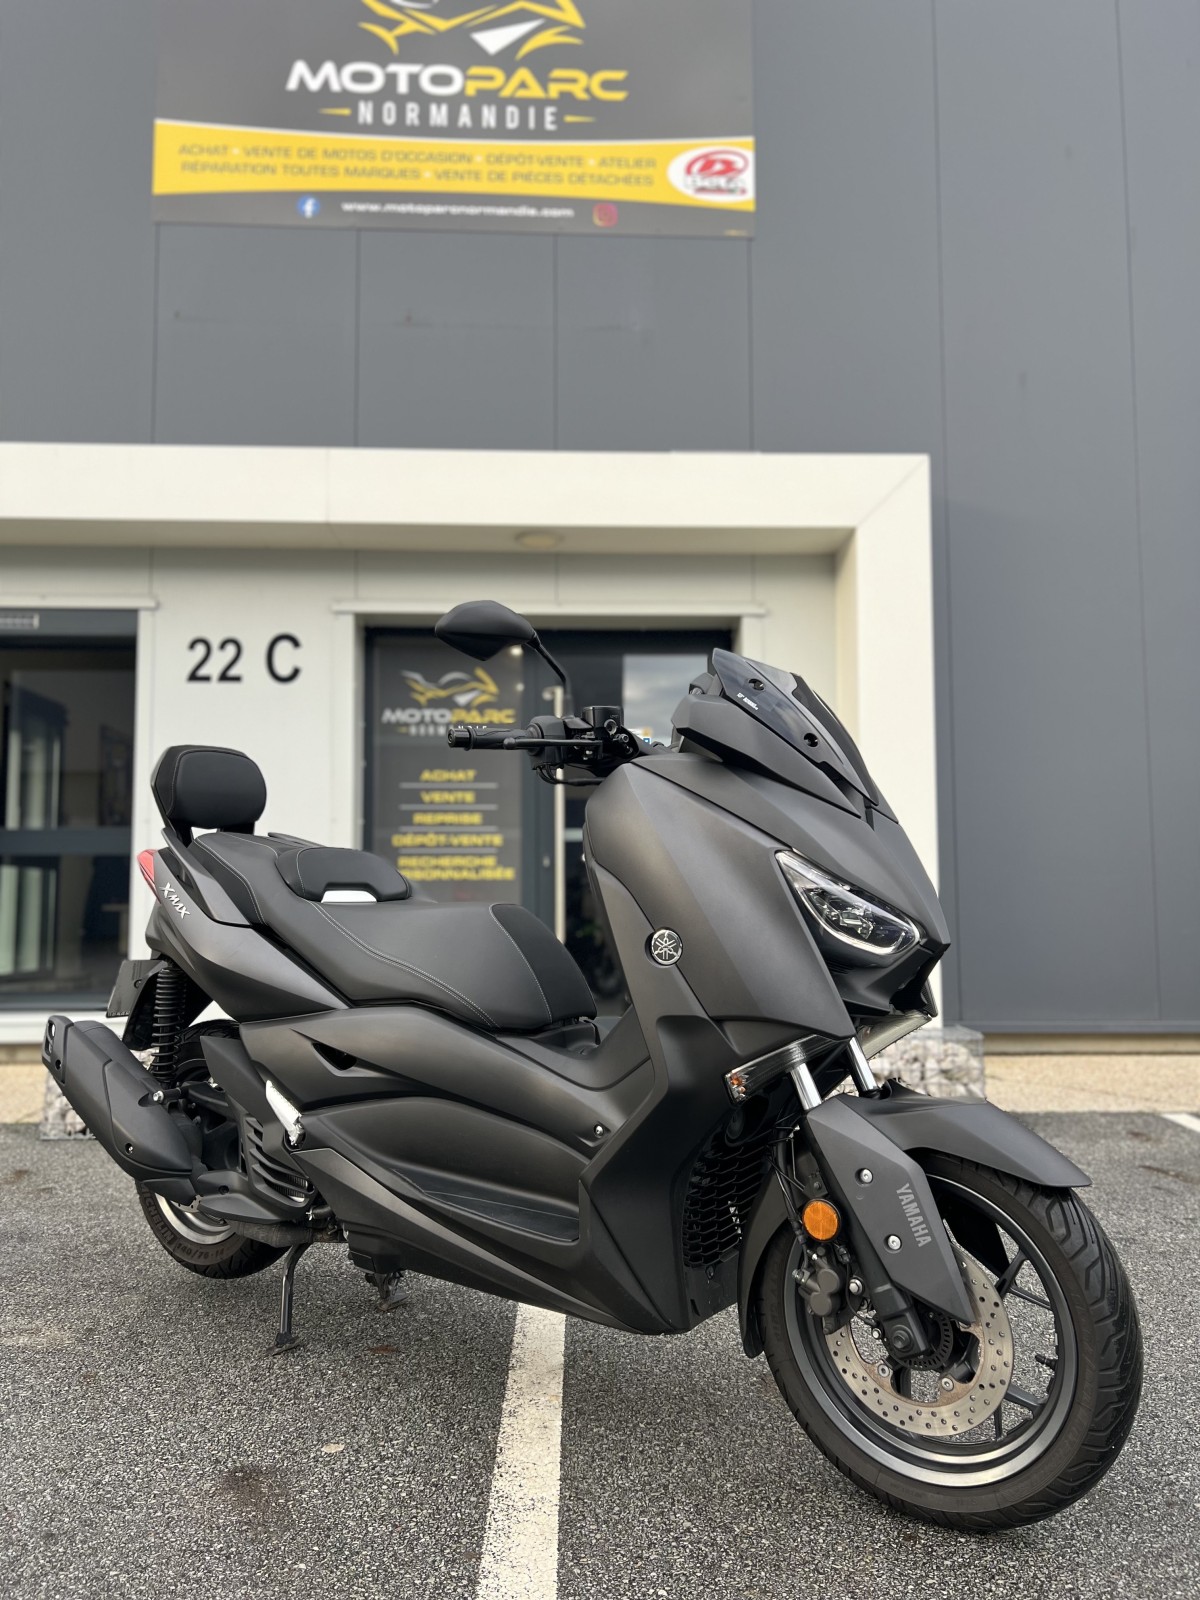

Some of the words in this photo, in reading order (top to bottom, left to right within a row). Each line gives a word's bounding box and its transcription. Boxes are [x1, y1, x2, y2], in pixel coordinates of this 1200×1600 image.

[285, 60, 629, 101] MOTOPARC
[357, 101, 558, 130] NORMANDIE
[178, 143, 228, 156] ACHAT
[243, 145, 291, 159] VENTE
[296, 147, 317, 159] DE
[322, 148, 376, 161] MOTOS
[381, 149, 473, 164] D'OCCASION
[597, 156, 657, 169] ATELIER
[180, 160, 277, 175] RÉPARATION
[283, 163, 339, 177] TOUTES
[344, 164, 420, 179] MARQUES
[433, 169, 482, 182] VENTE
[487, 171, 507, 183] DE
[187, 637, 243, 683] 22
[266, 632, 302, 685] C
[381, 707, 517, 724] MOTOPARC
[419, 768, 478, 782] ACHAT
[420, 790, 476, 804] VENTE
[412, 812, 483, 825] REPRISE
[397, 855, 498, 868] RECHERCHE
[896, 1182, 932, 1248] YAMAHA
